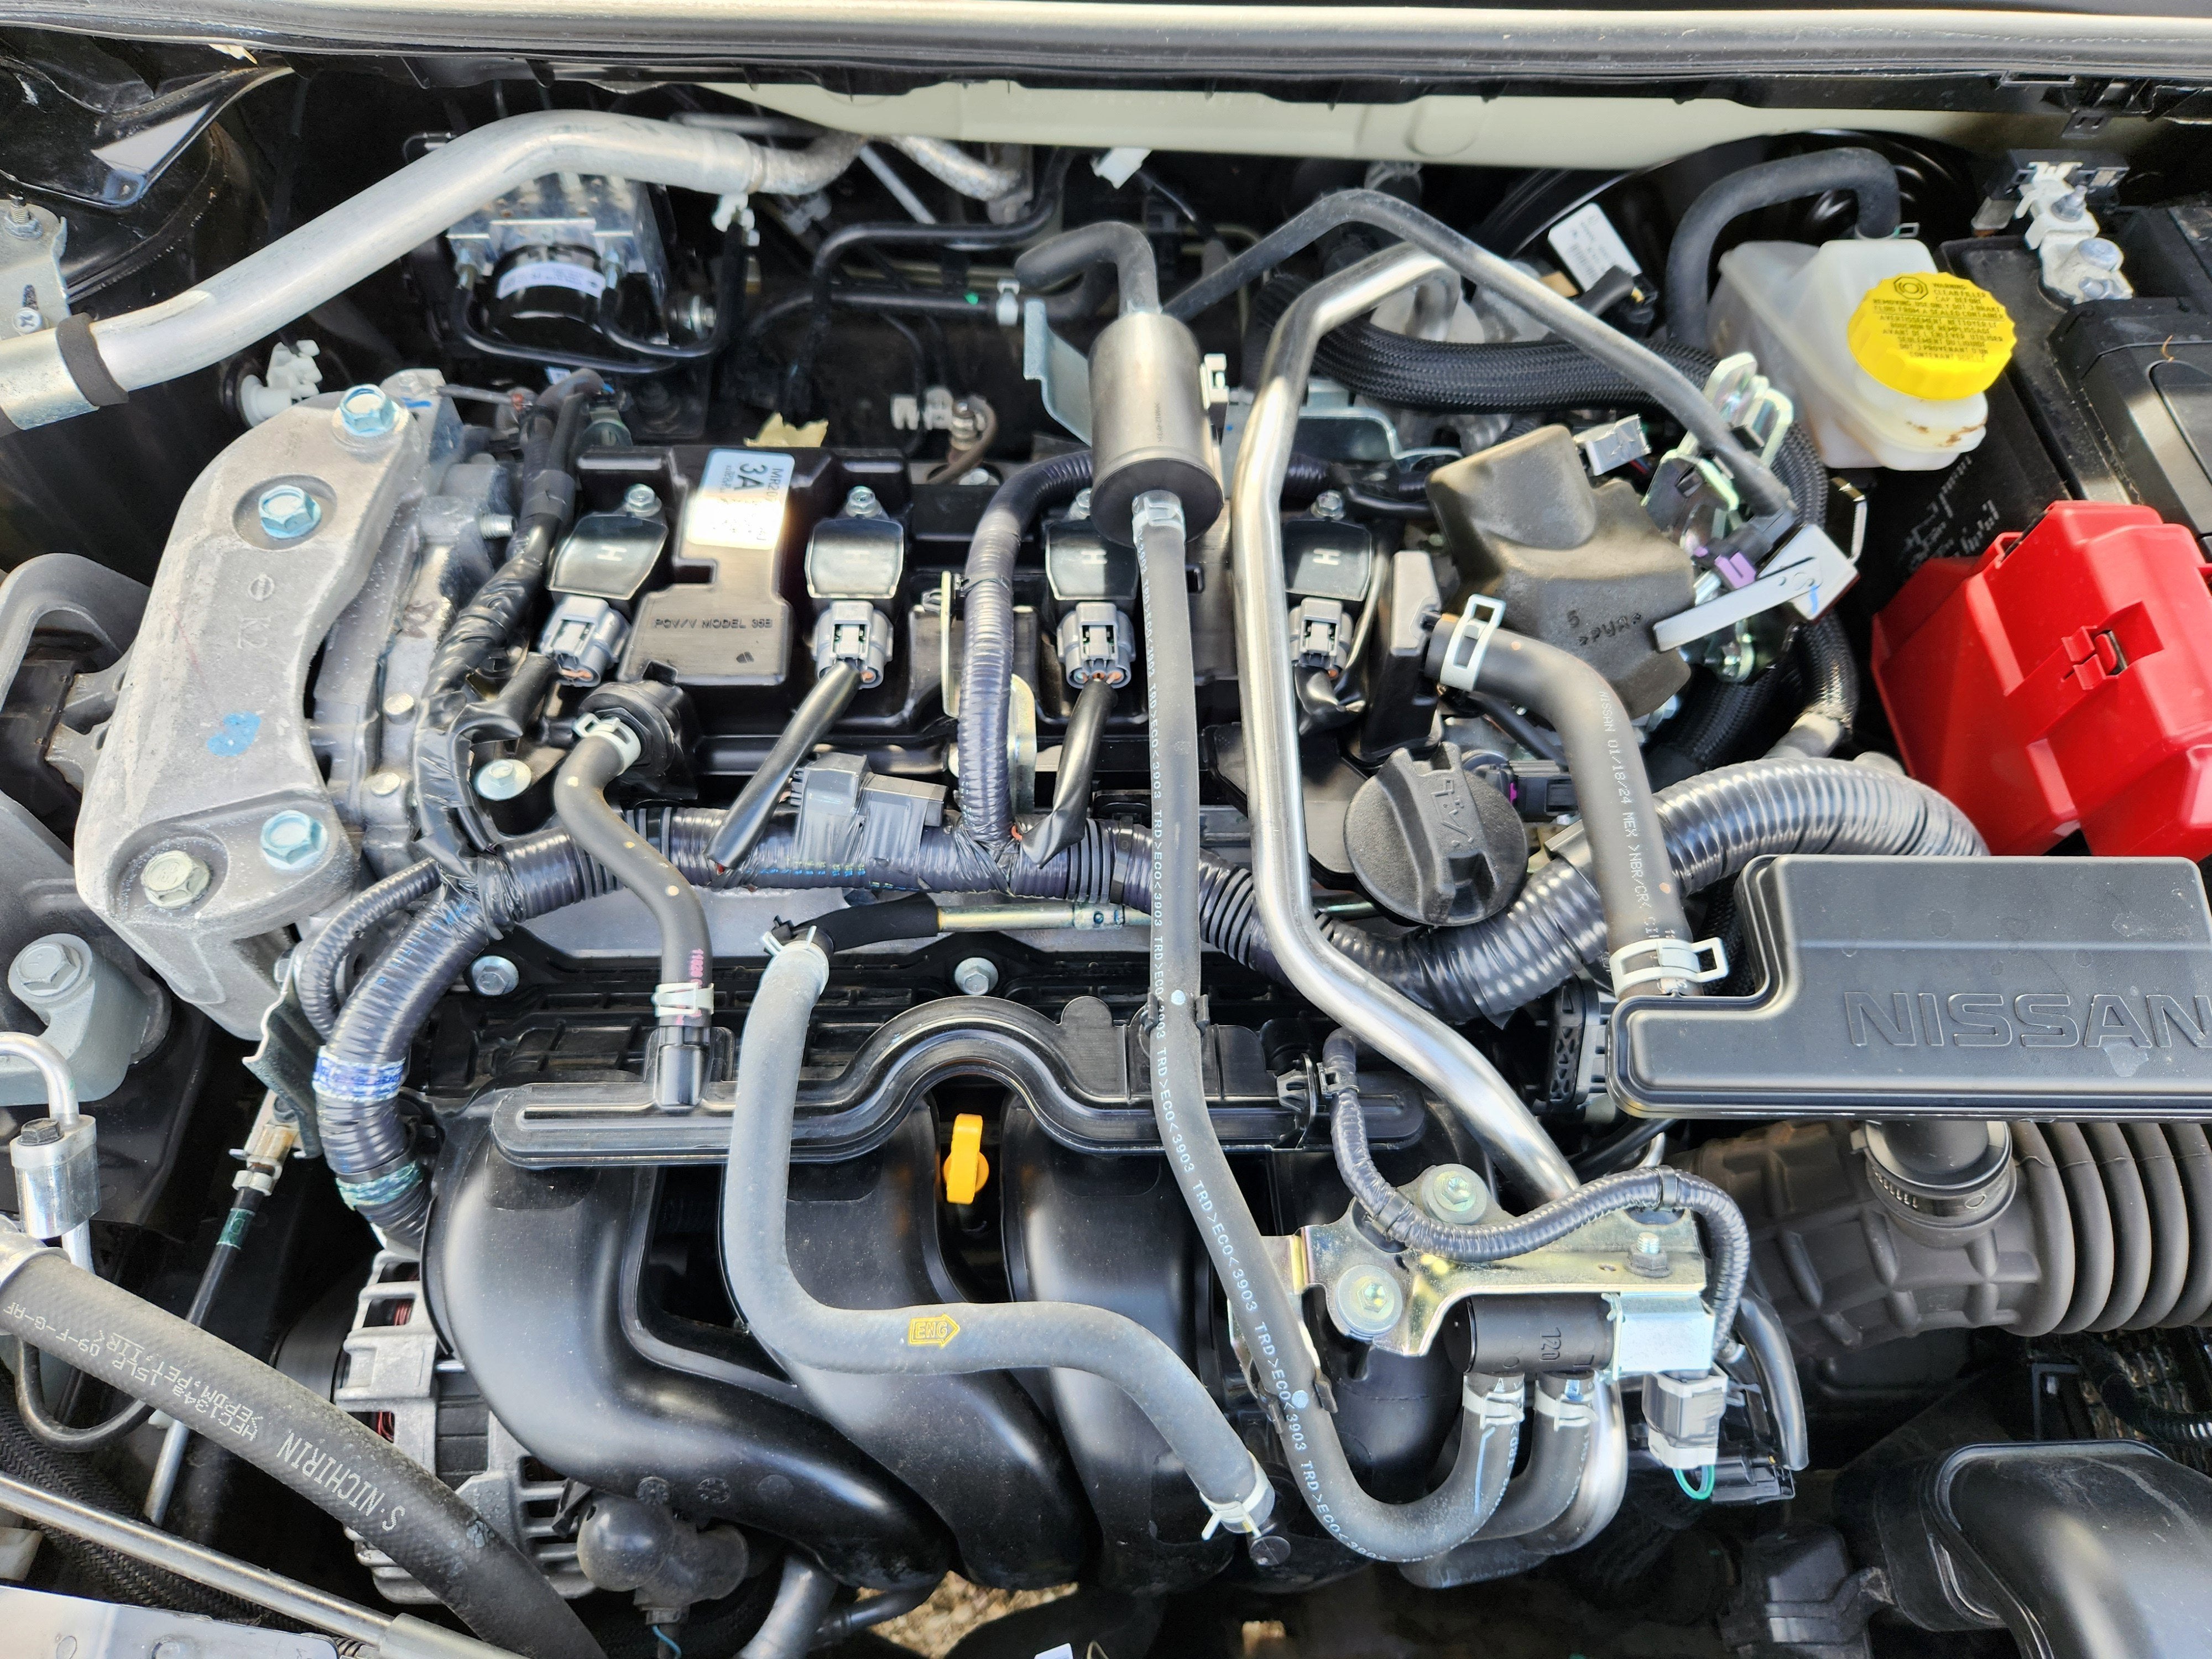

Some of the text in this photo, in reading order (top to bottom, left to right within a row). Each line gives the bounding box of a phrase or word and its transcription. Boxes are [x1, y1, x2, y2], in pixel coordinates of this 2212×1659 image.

[733, 463, 768, 491] 3A
[701, 618, 747, 629] MODEL
[1599, 691, 1615, 732] NISSAN
[1607, 739, 1632, 804] 01/18/24
[1622, 811, 1639, 837] MEX
[1844, 992, 2212, 1048] NISSAN
[915, 1321, 948, 1338] ENG
[1540, 1327, 1562, 1361] 120
